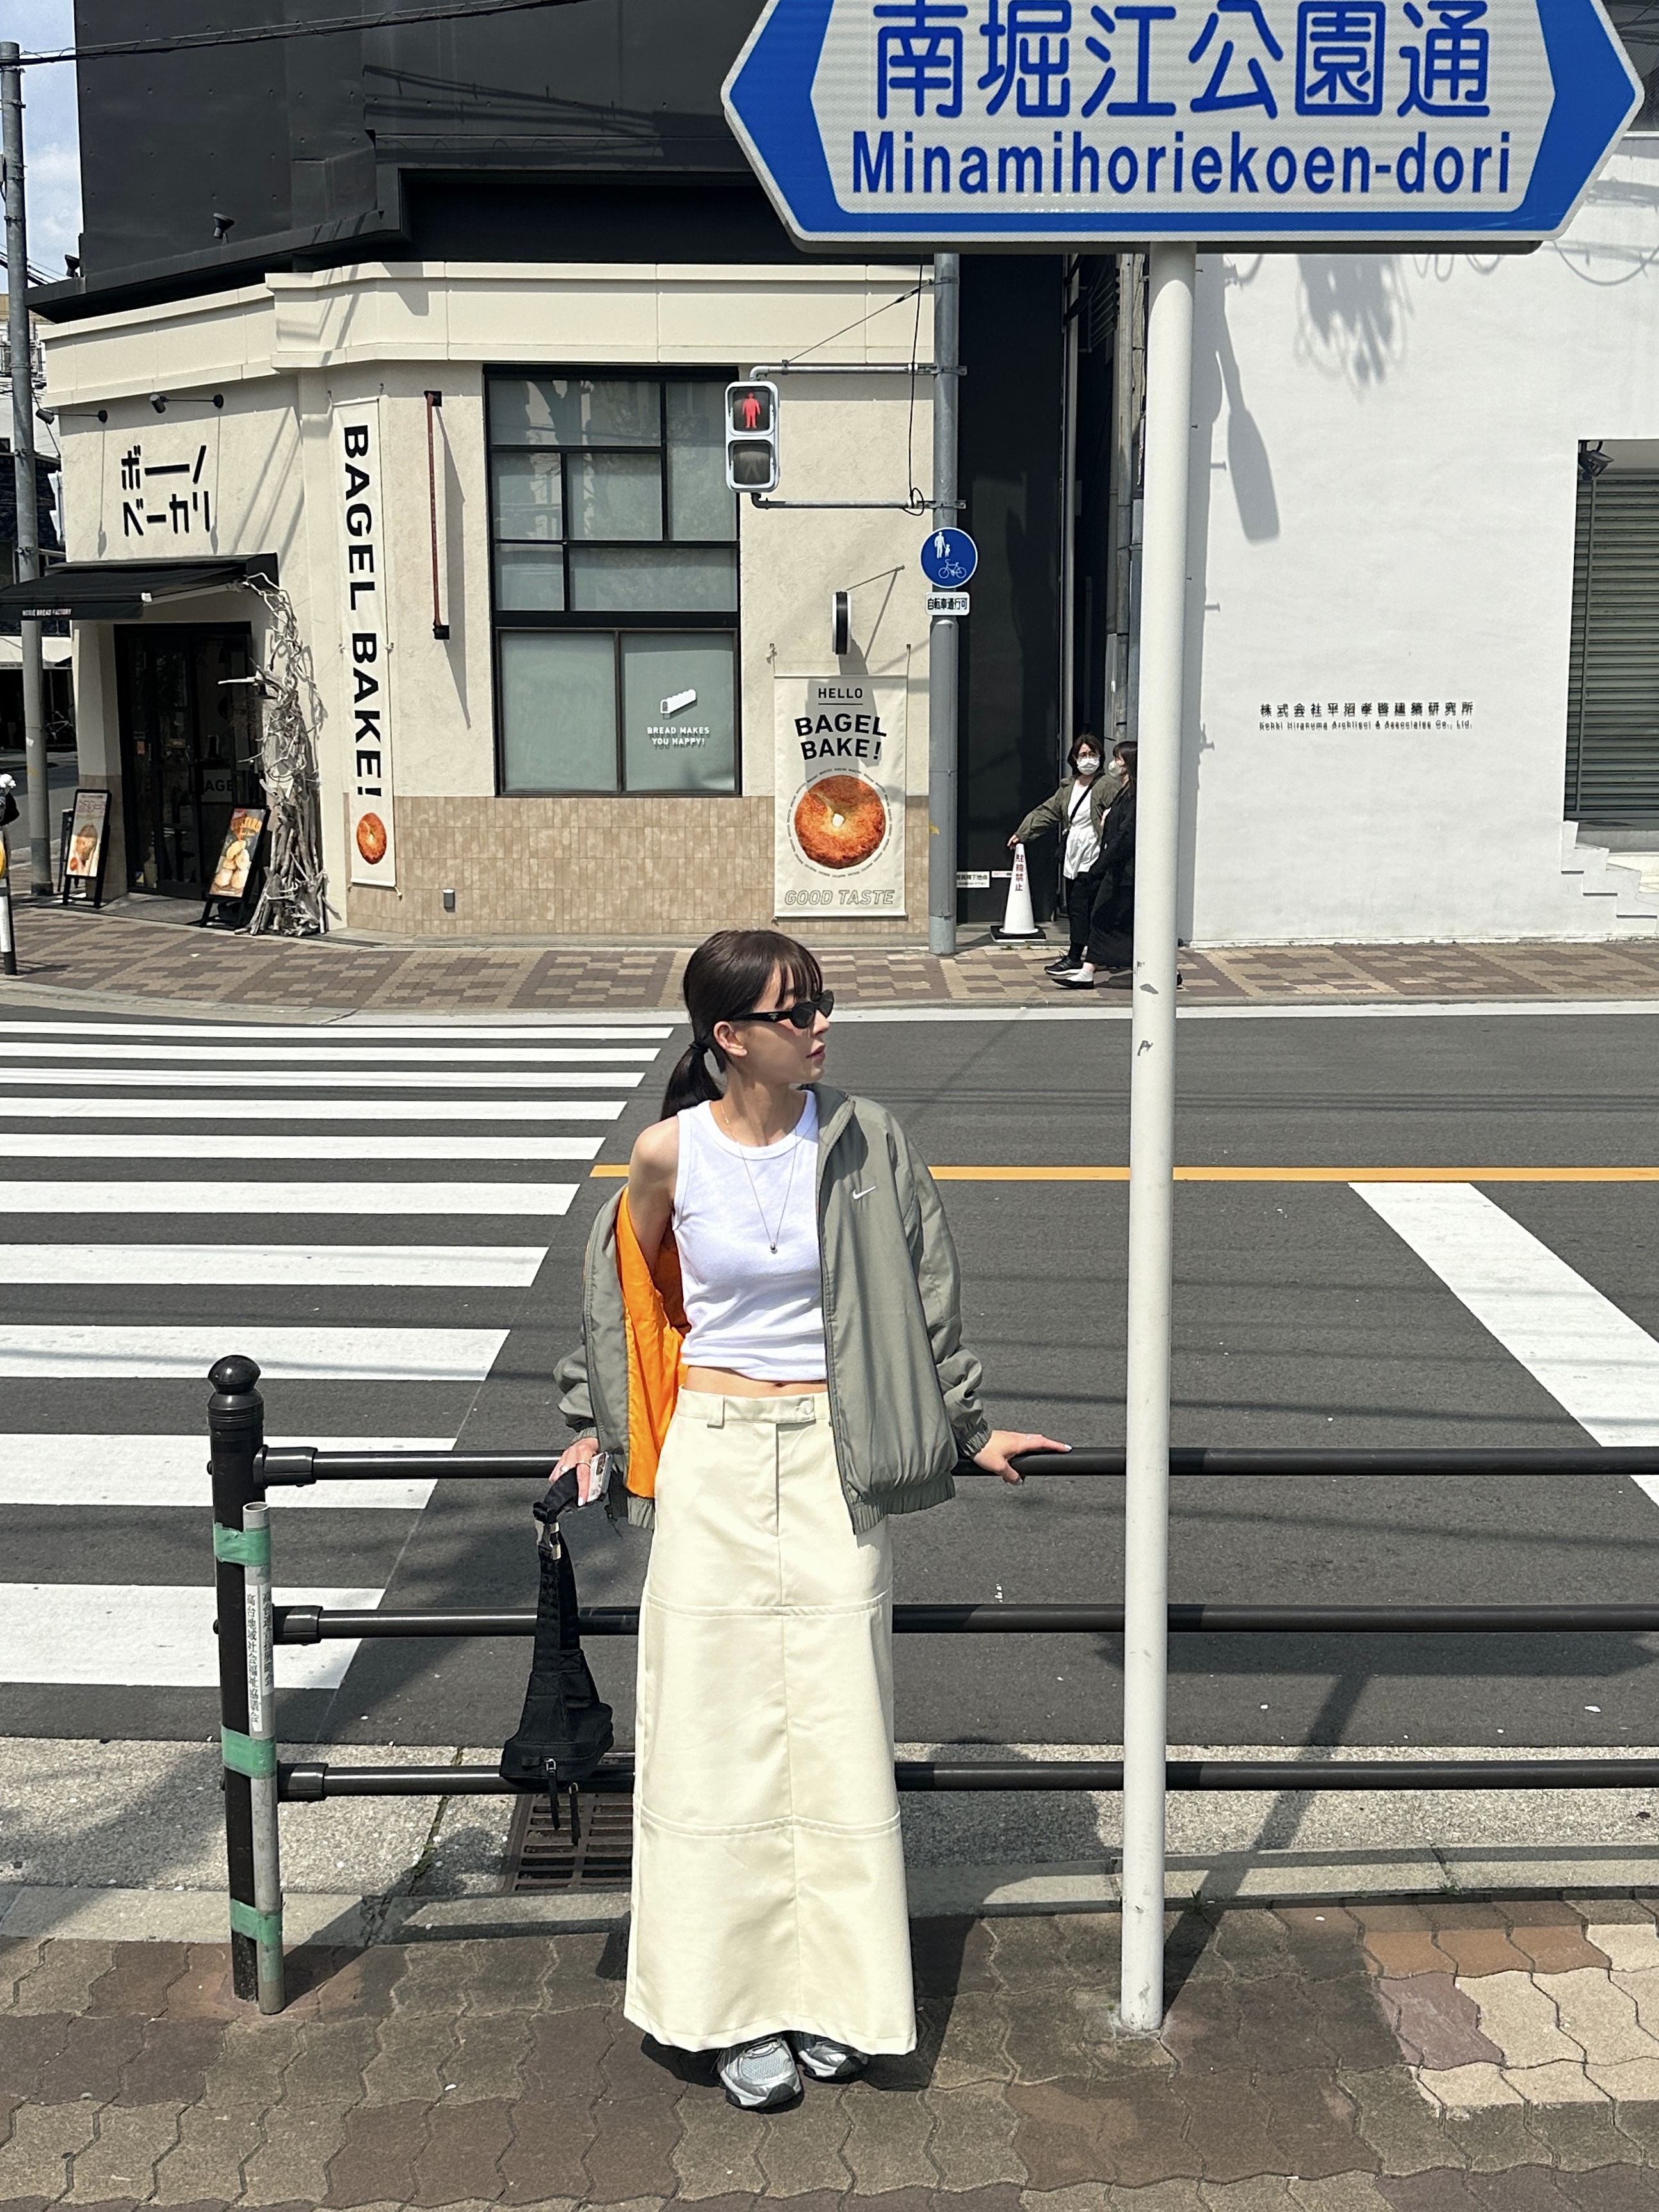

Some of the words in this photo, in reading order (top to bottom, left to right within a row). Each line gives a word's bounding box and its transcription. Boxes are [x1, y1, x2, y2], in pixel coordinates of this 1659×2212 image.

[873, 0, 1491, 119] 南堀江公園通
[853, 131, 1510, 195] Minamihoriekoen-dori
[121, 445, 207, 490] ボーノ
[123, 490, 210, 537] ベーカリ
[344, 425, 375, 611] BAGEL
[927, 597, 967, 610] 自転車通行可
[352, 633, 382, 797] BAKE!
[818, 688, 863, 698] HELLO
[795, 713, 887, 737] BAGEL
[800, 738, 882, 761] BAKE!
[784, 890, 833, 905] GOOD
[838, 889, 895, 905] TASTE
